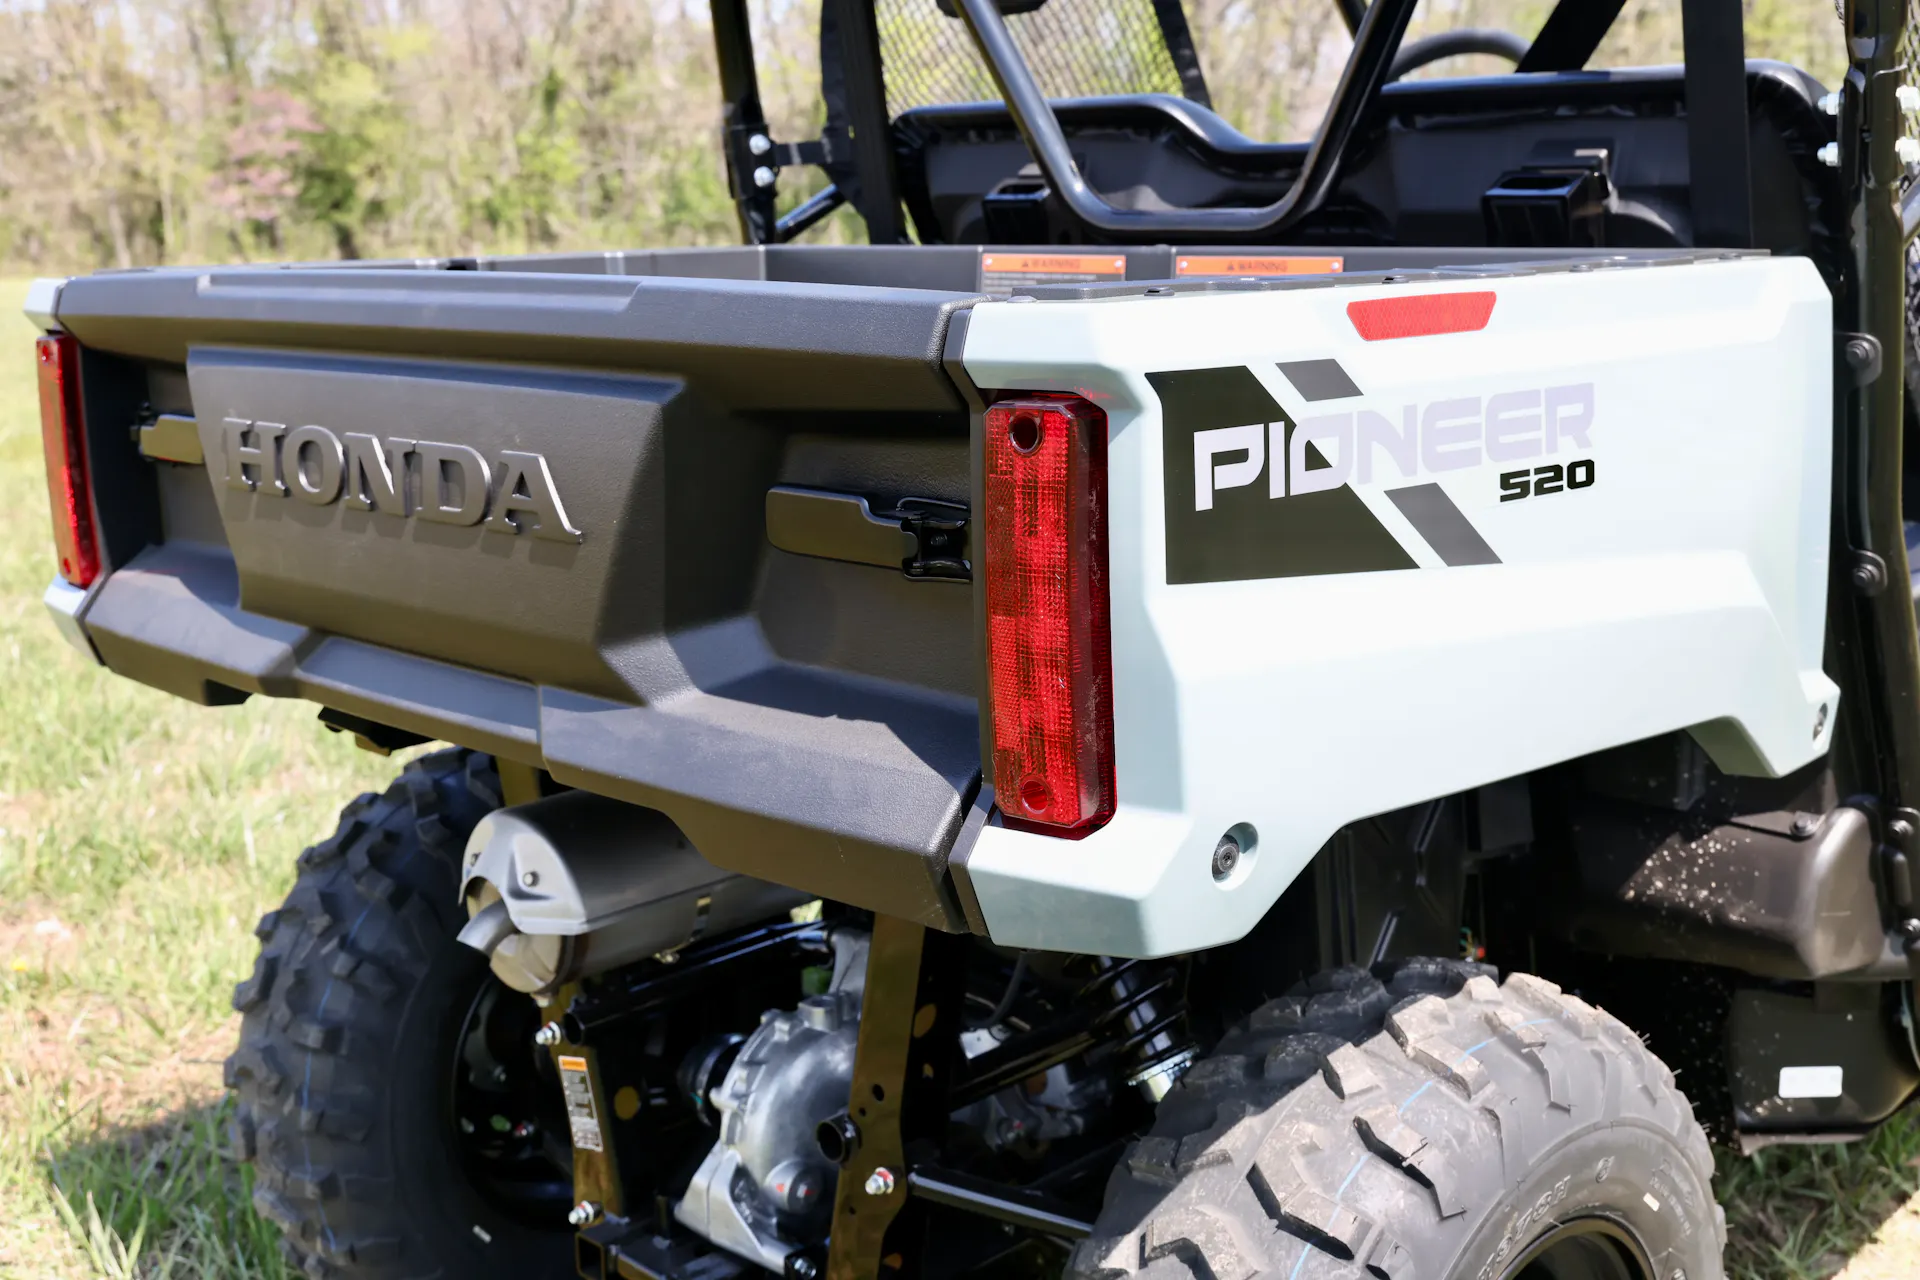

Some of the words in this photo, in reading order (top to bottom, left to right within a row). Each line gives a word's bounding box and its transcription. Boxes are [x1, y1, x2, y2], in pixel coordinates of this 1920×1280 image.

[1239, 260, 1288, 273] WARNING
[222, 416, 583, 545] HONDA
[1193, 382, 1595, 512] PIONEER
[1499, 459, 1596, 503] 520
